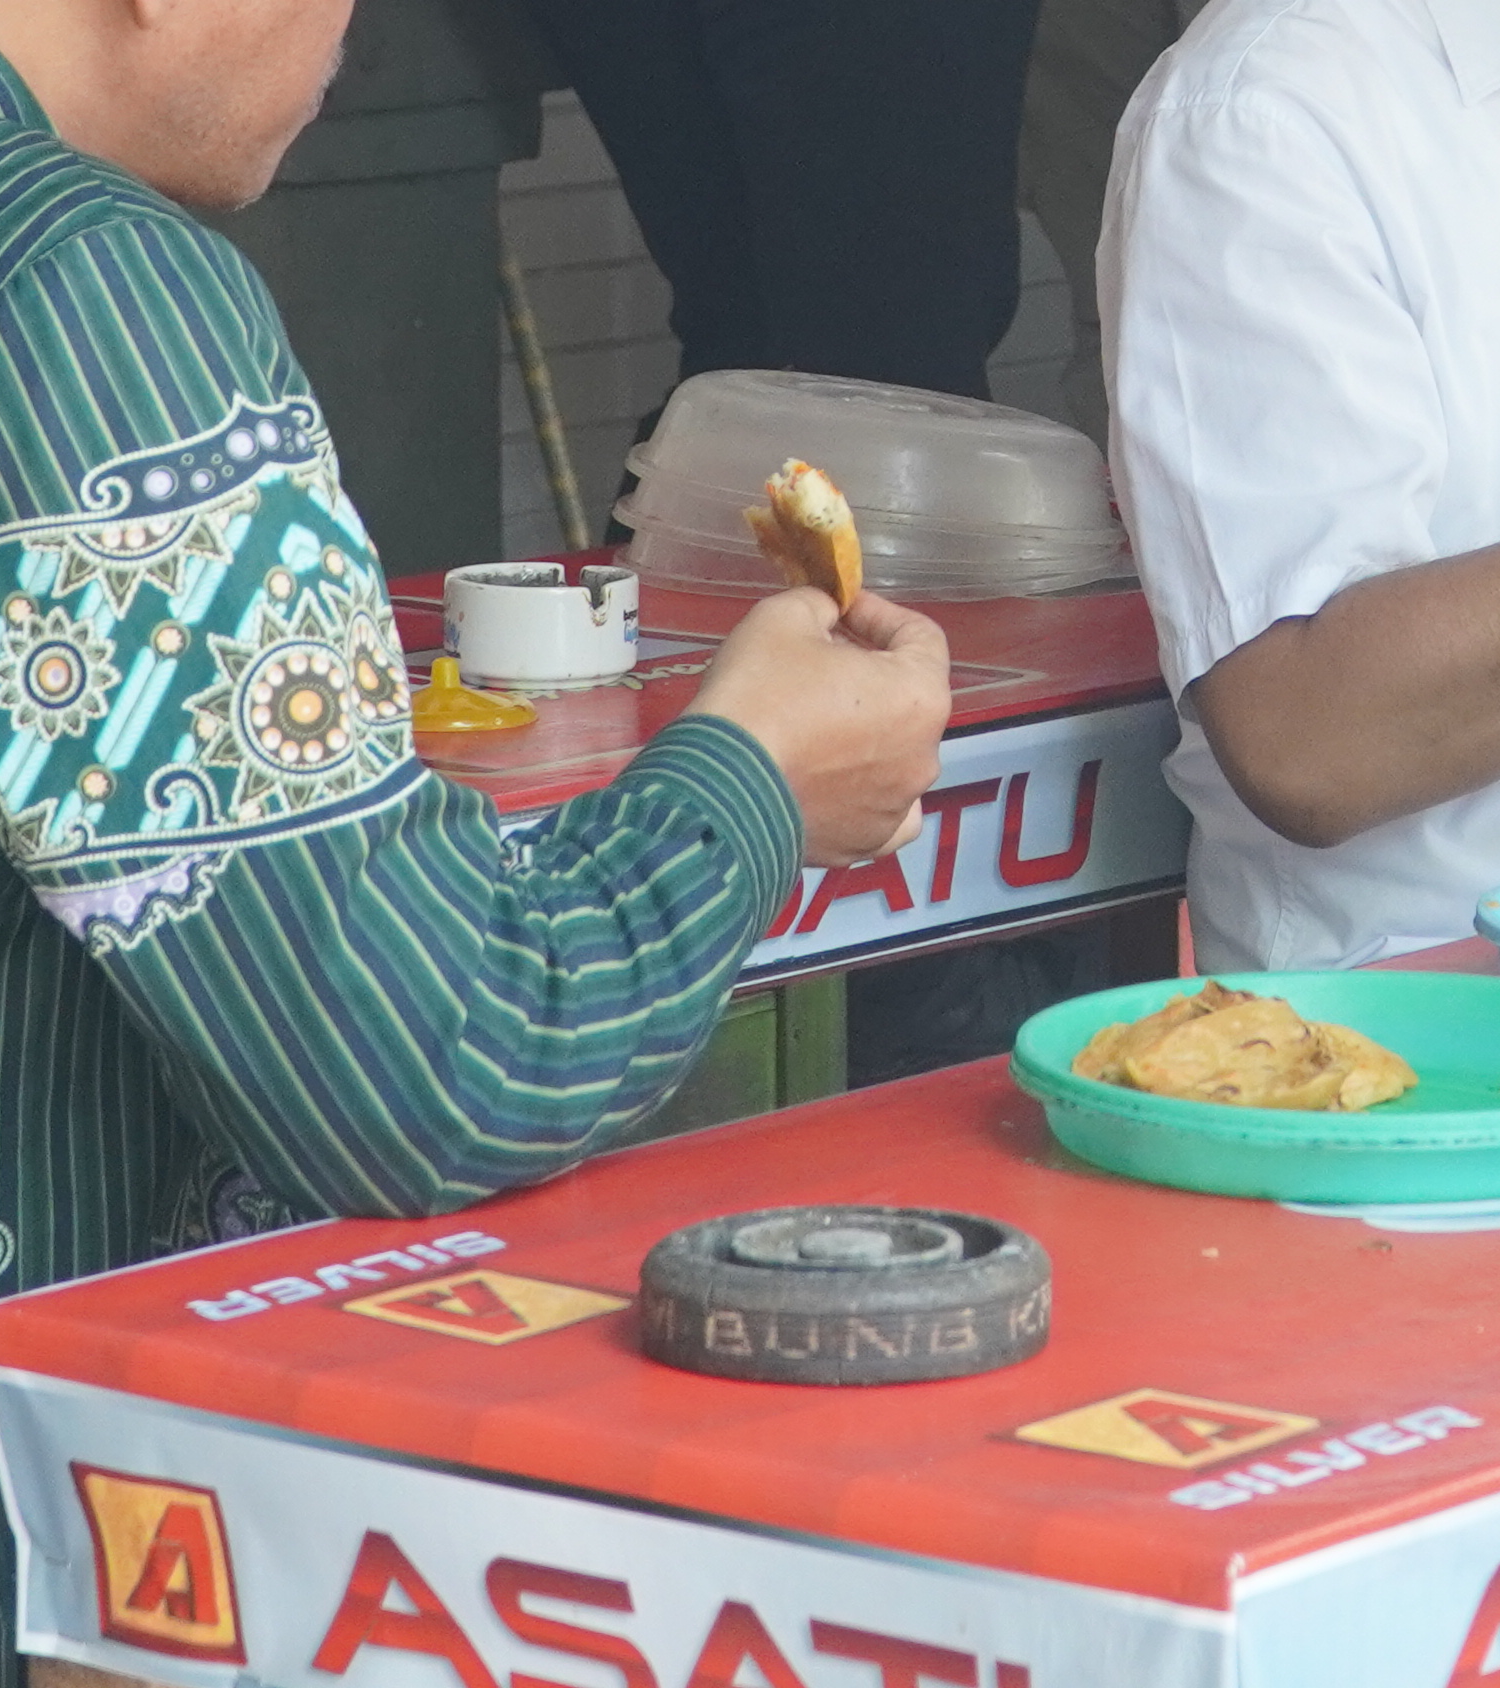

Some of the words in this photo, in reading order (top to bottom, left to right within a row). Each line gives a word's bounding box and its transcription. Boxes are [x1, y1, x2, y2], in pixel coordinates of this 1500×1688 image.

[187, 1231, 507, 1321] SILVER
[704, 1309, 982, 1360] BUNG
[1168, 1405, 1485, 1511] SILVER
